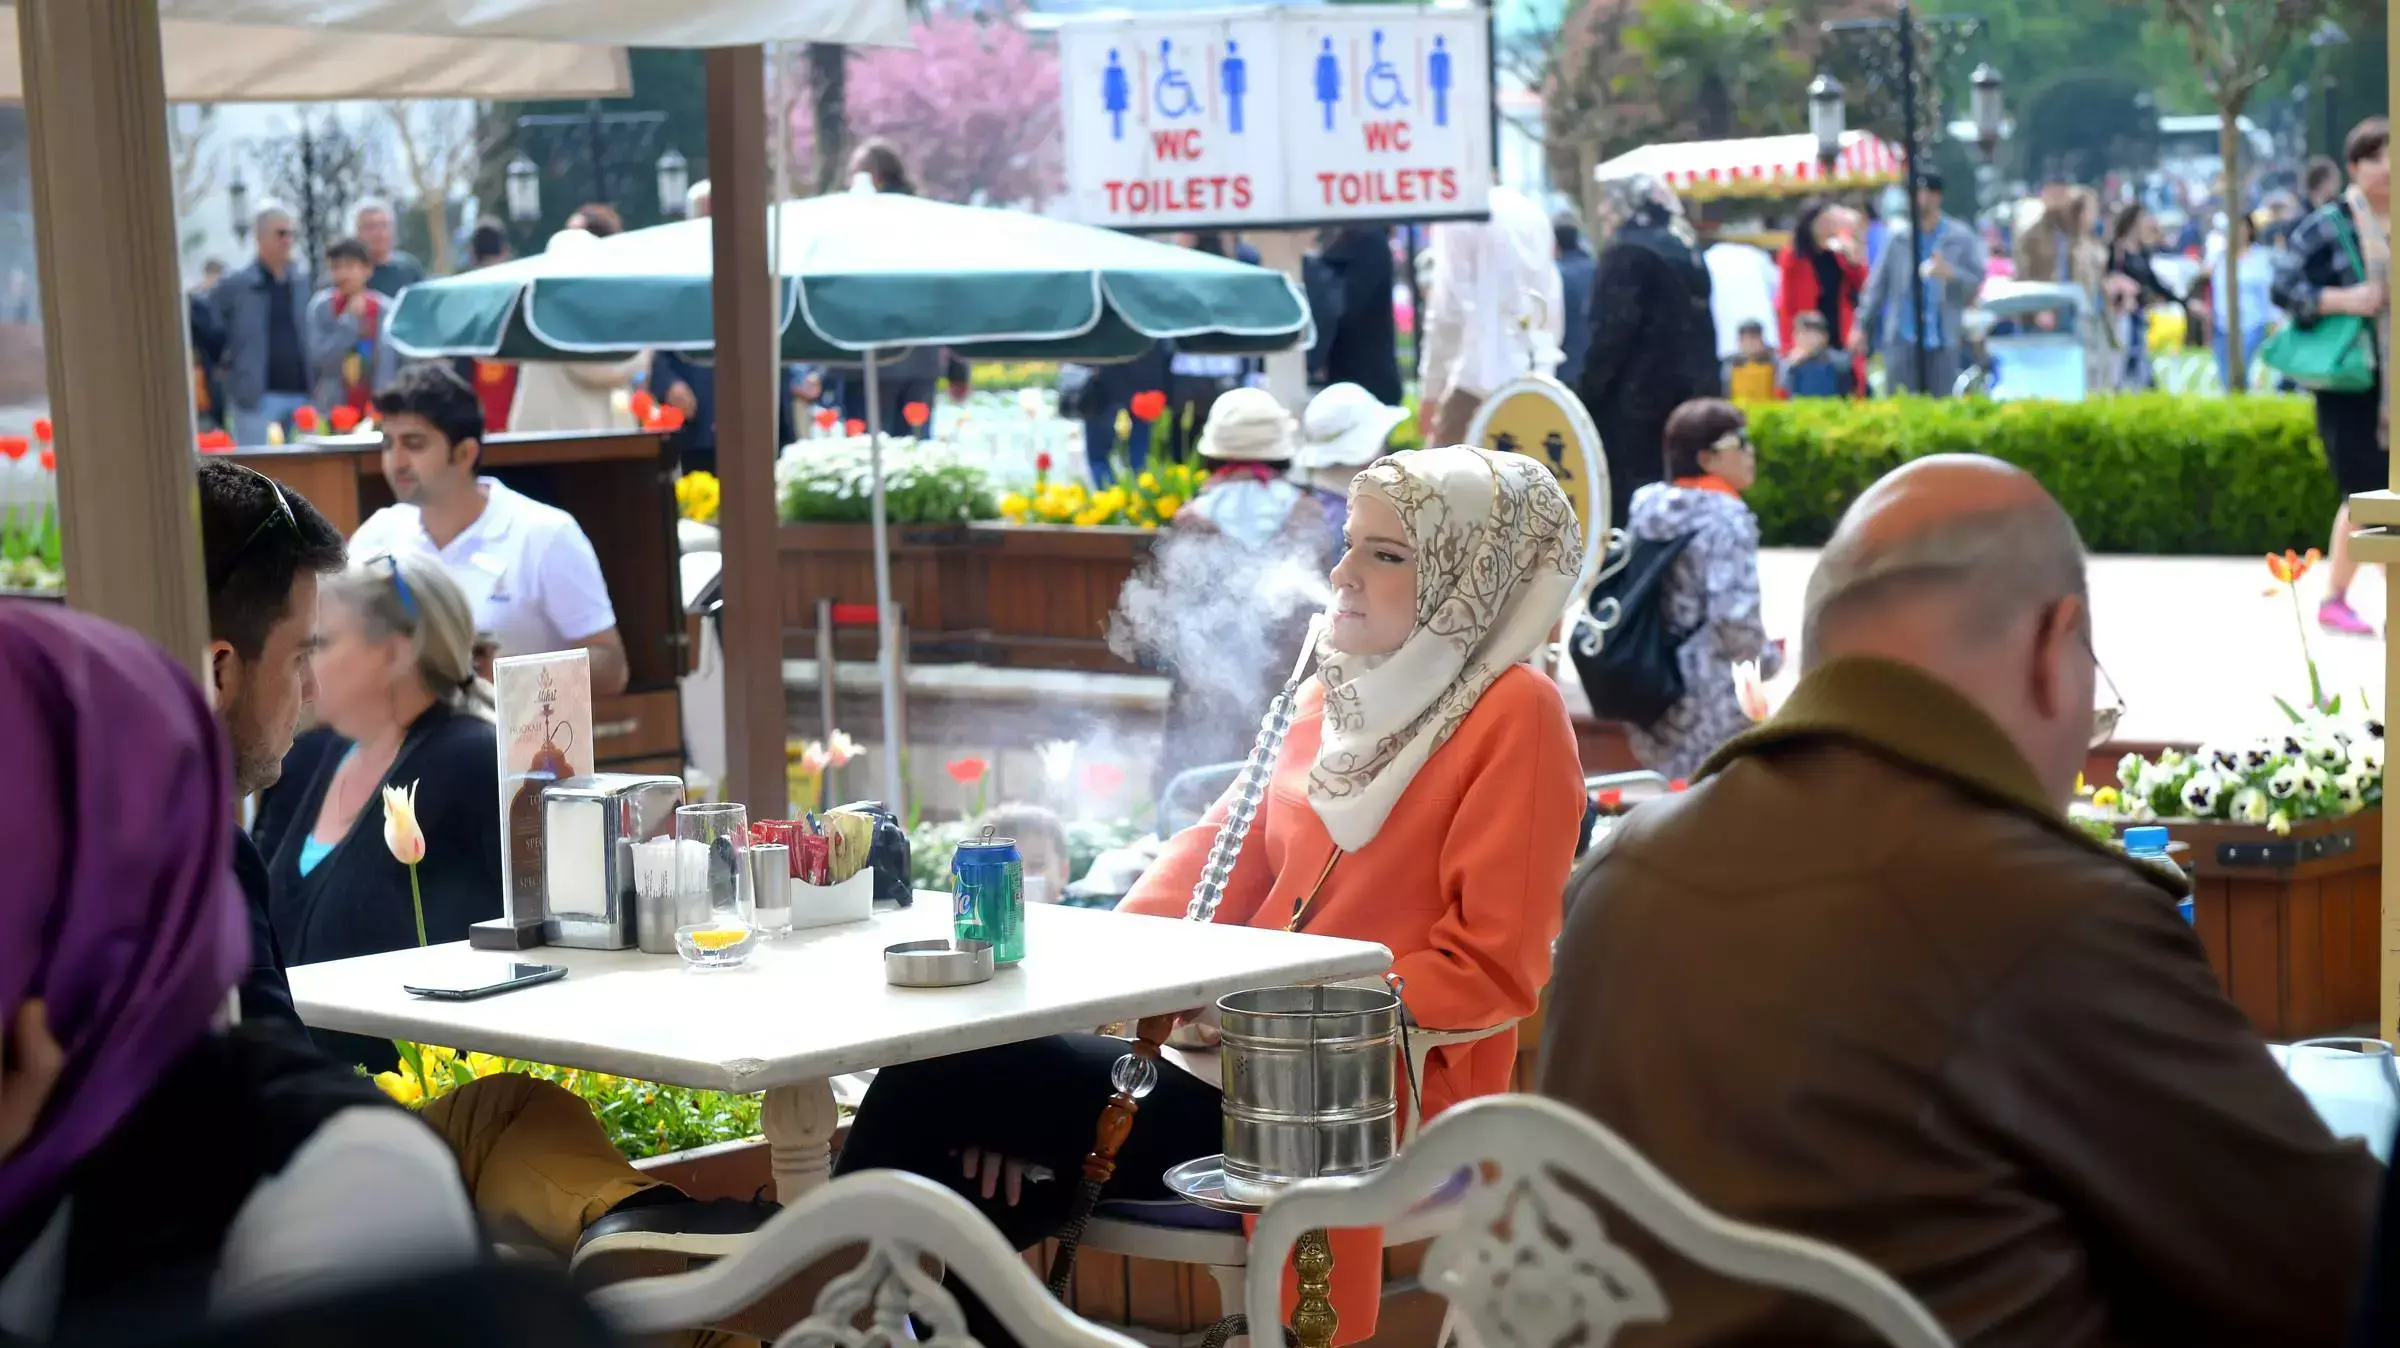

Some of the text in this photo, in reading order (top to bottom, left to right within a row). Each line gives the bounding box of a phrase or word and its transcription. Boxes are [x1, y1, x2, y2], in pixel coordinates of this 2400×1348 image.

[1152, 129, 1203, 161] WC
[1363, 121, 1412, 153] WC
[1104, 175, 1253, 213] TOILETS
[1316, 168, 1458, 206] TOILETS
